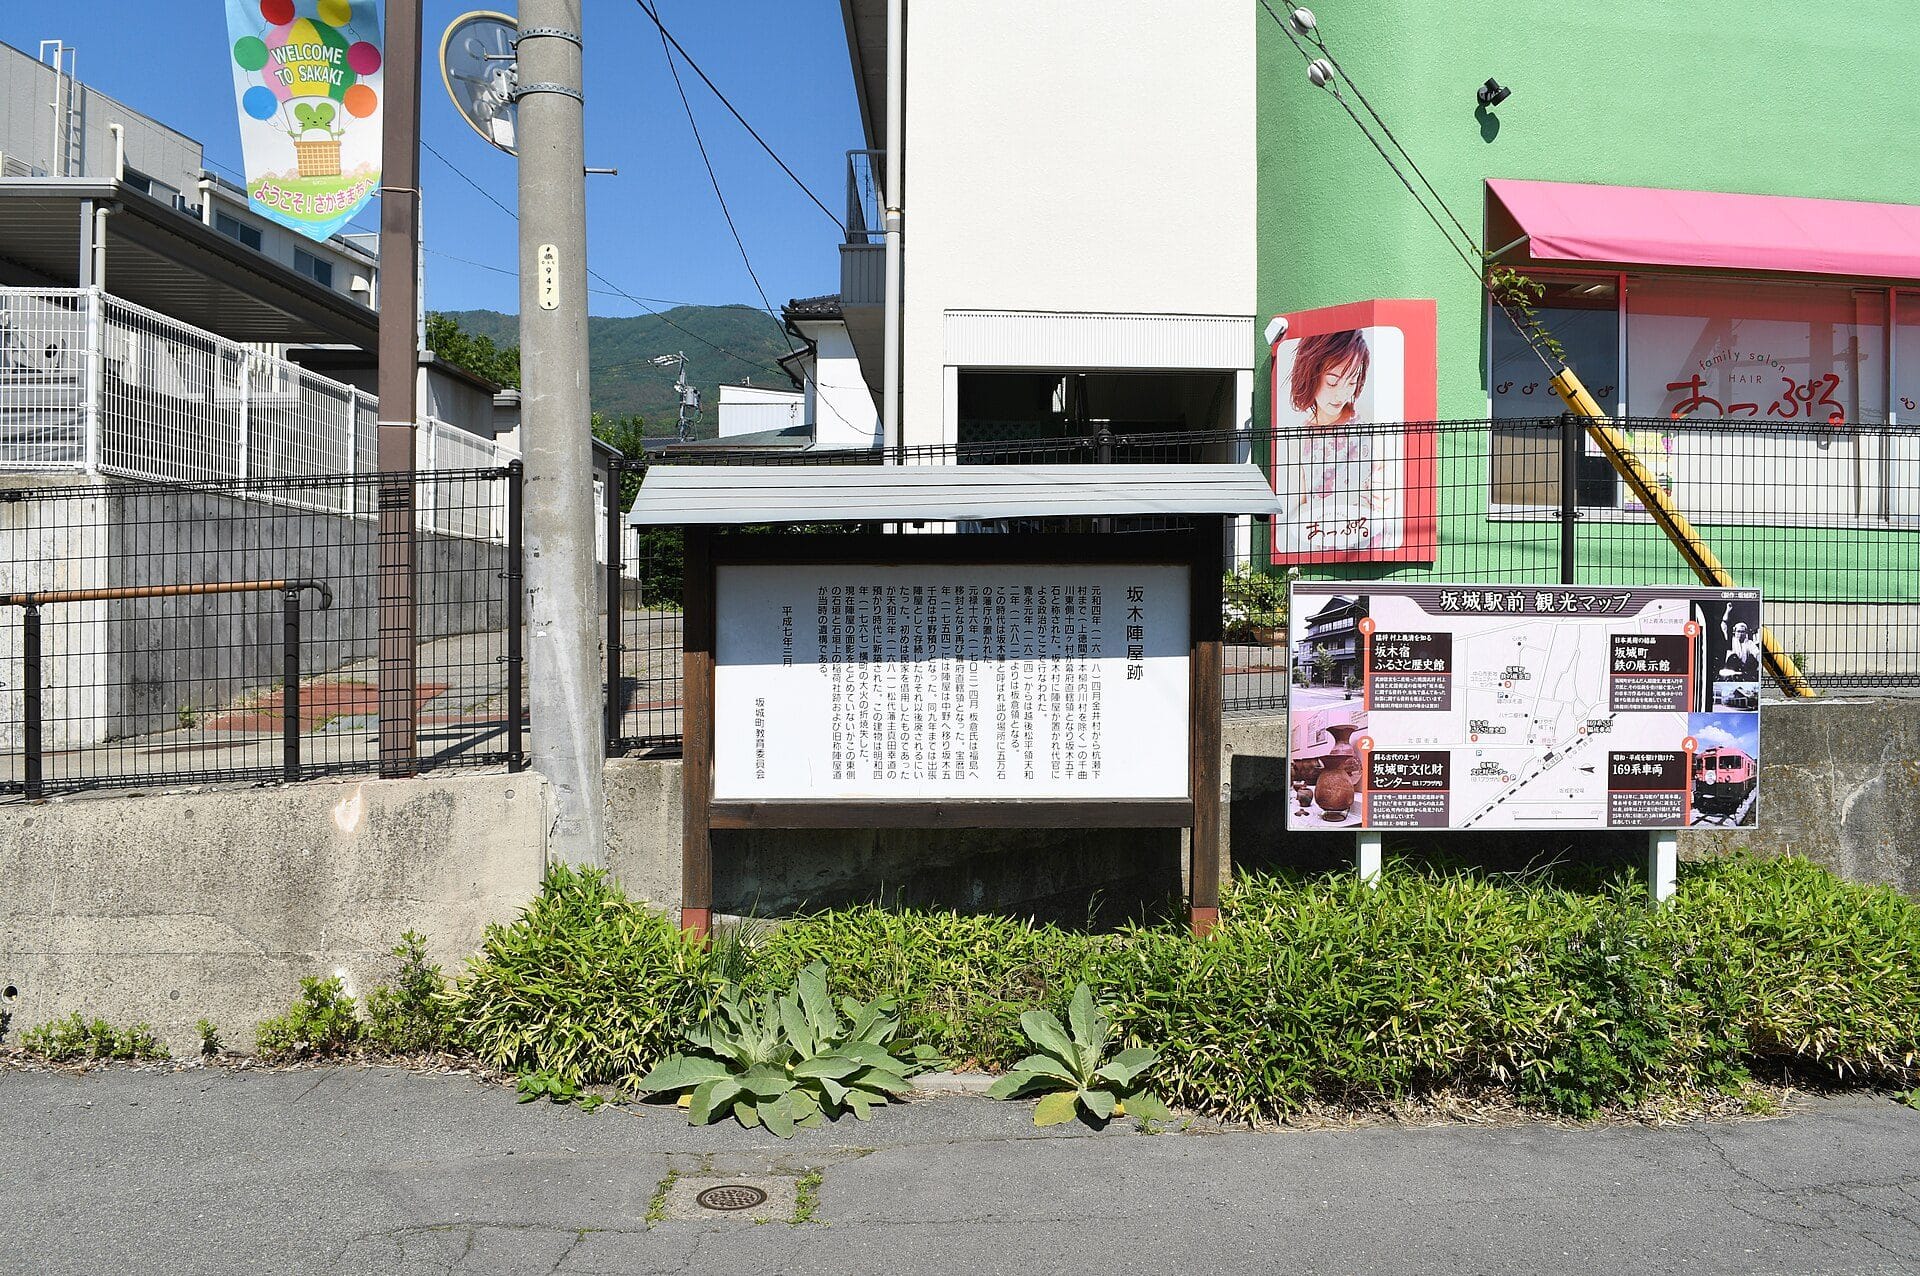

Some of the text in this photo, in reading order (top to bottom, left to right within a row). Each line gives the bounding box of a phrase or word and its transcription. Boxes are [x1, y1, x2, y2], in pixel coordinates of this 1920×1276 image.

[271, 44, 343, 65] WELCOME
[274, 65, 344, 86] TO SAKAKI
[1699, 350, 1787, 374] family salon
[1728, 374, 1763, 384] HAIR
[1440, 590, 1632, 613] 坂城駅前 観光マップ
[1362, 621, 1370, 632] 1
[1687, 625, 1696, 635] 3
[782, 606, 793, 667] 平成七年三月
[1126, 586, 1144, 681] 坂木陣屋跡
[1375, 646, 1410, 658] 坂木宿
[1614, 647, 1649, 659] 坂城町
[1375, 659, 1445, 671] ふるさと歴史館
[1614, 659, 1670, 672] 鉄の展示館
[755, 698, 765, 780] 坂城町教育委員会
[1361, 739, 1371, 750] 2
[1685, 740, 1693, 750] 4
[1374, 764, 1443, 775] 坂城町文化財
[1613, 764, 1662, 776] 169系車両
[1374, 777, 1410, 788] センター
